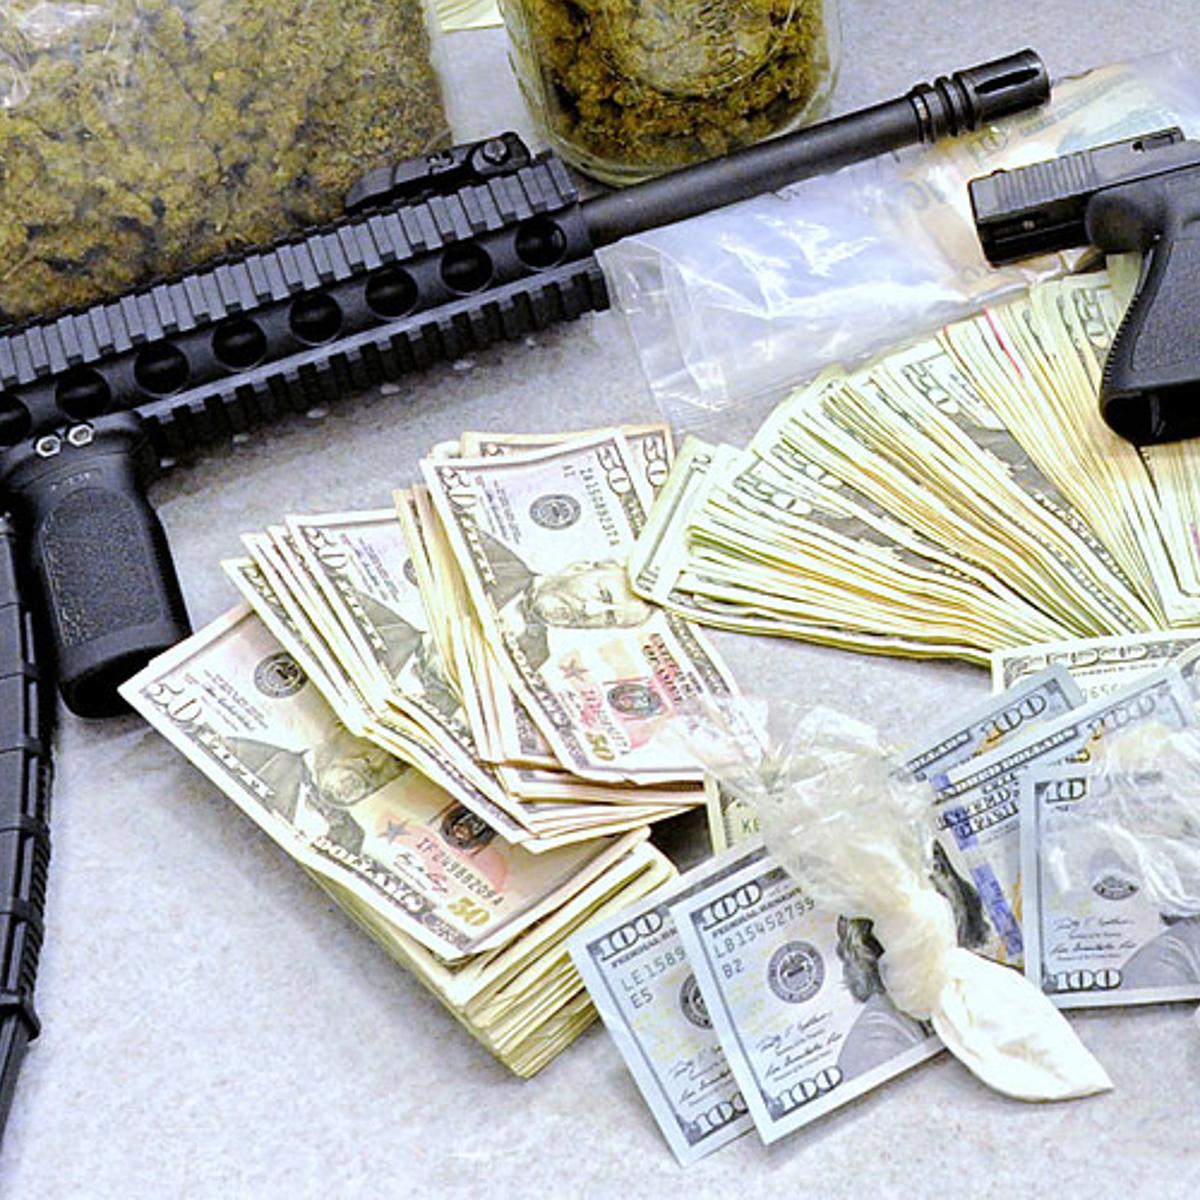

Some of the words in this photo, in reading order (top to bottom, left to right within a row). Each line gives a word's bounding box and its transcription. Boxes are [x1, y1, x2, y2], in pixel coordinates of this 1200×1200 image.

[596, 447, 634, 495] 50
[643, 436, 671, 489] 50
[439, 468, 477, 506] 50
[302, 526, 350, 569] 50
[146, 682, 202, 723] 50
[981, 693, 1048, 744] 100
[1001, 724, 1079, 773] DOLLARS
[447, 896, 492, 927] 50
[702, 879, 763, 931] 100
[600, 910, 664, 961] 100
[631, 988, 656, 1011] E5
[1055, 968, 1123, 991] 100
[776, 1063, 844, 1118] 100
